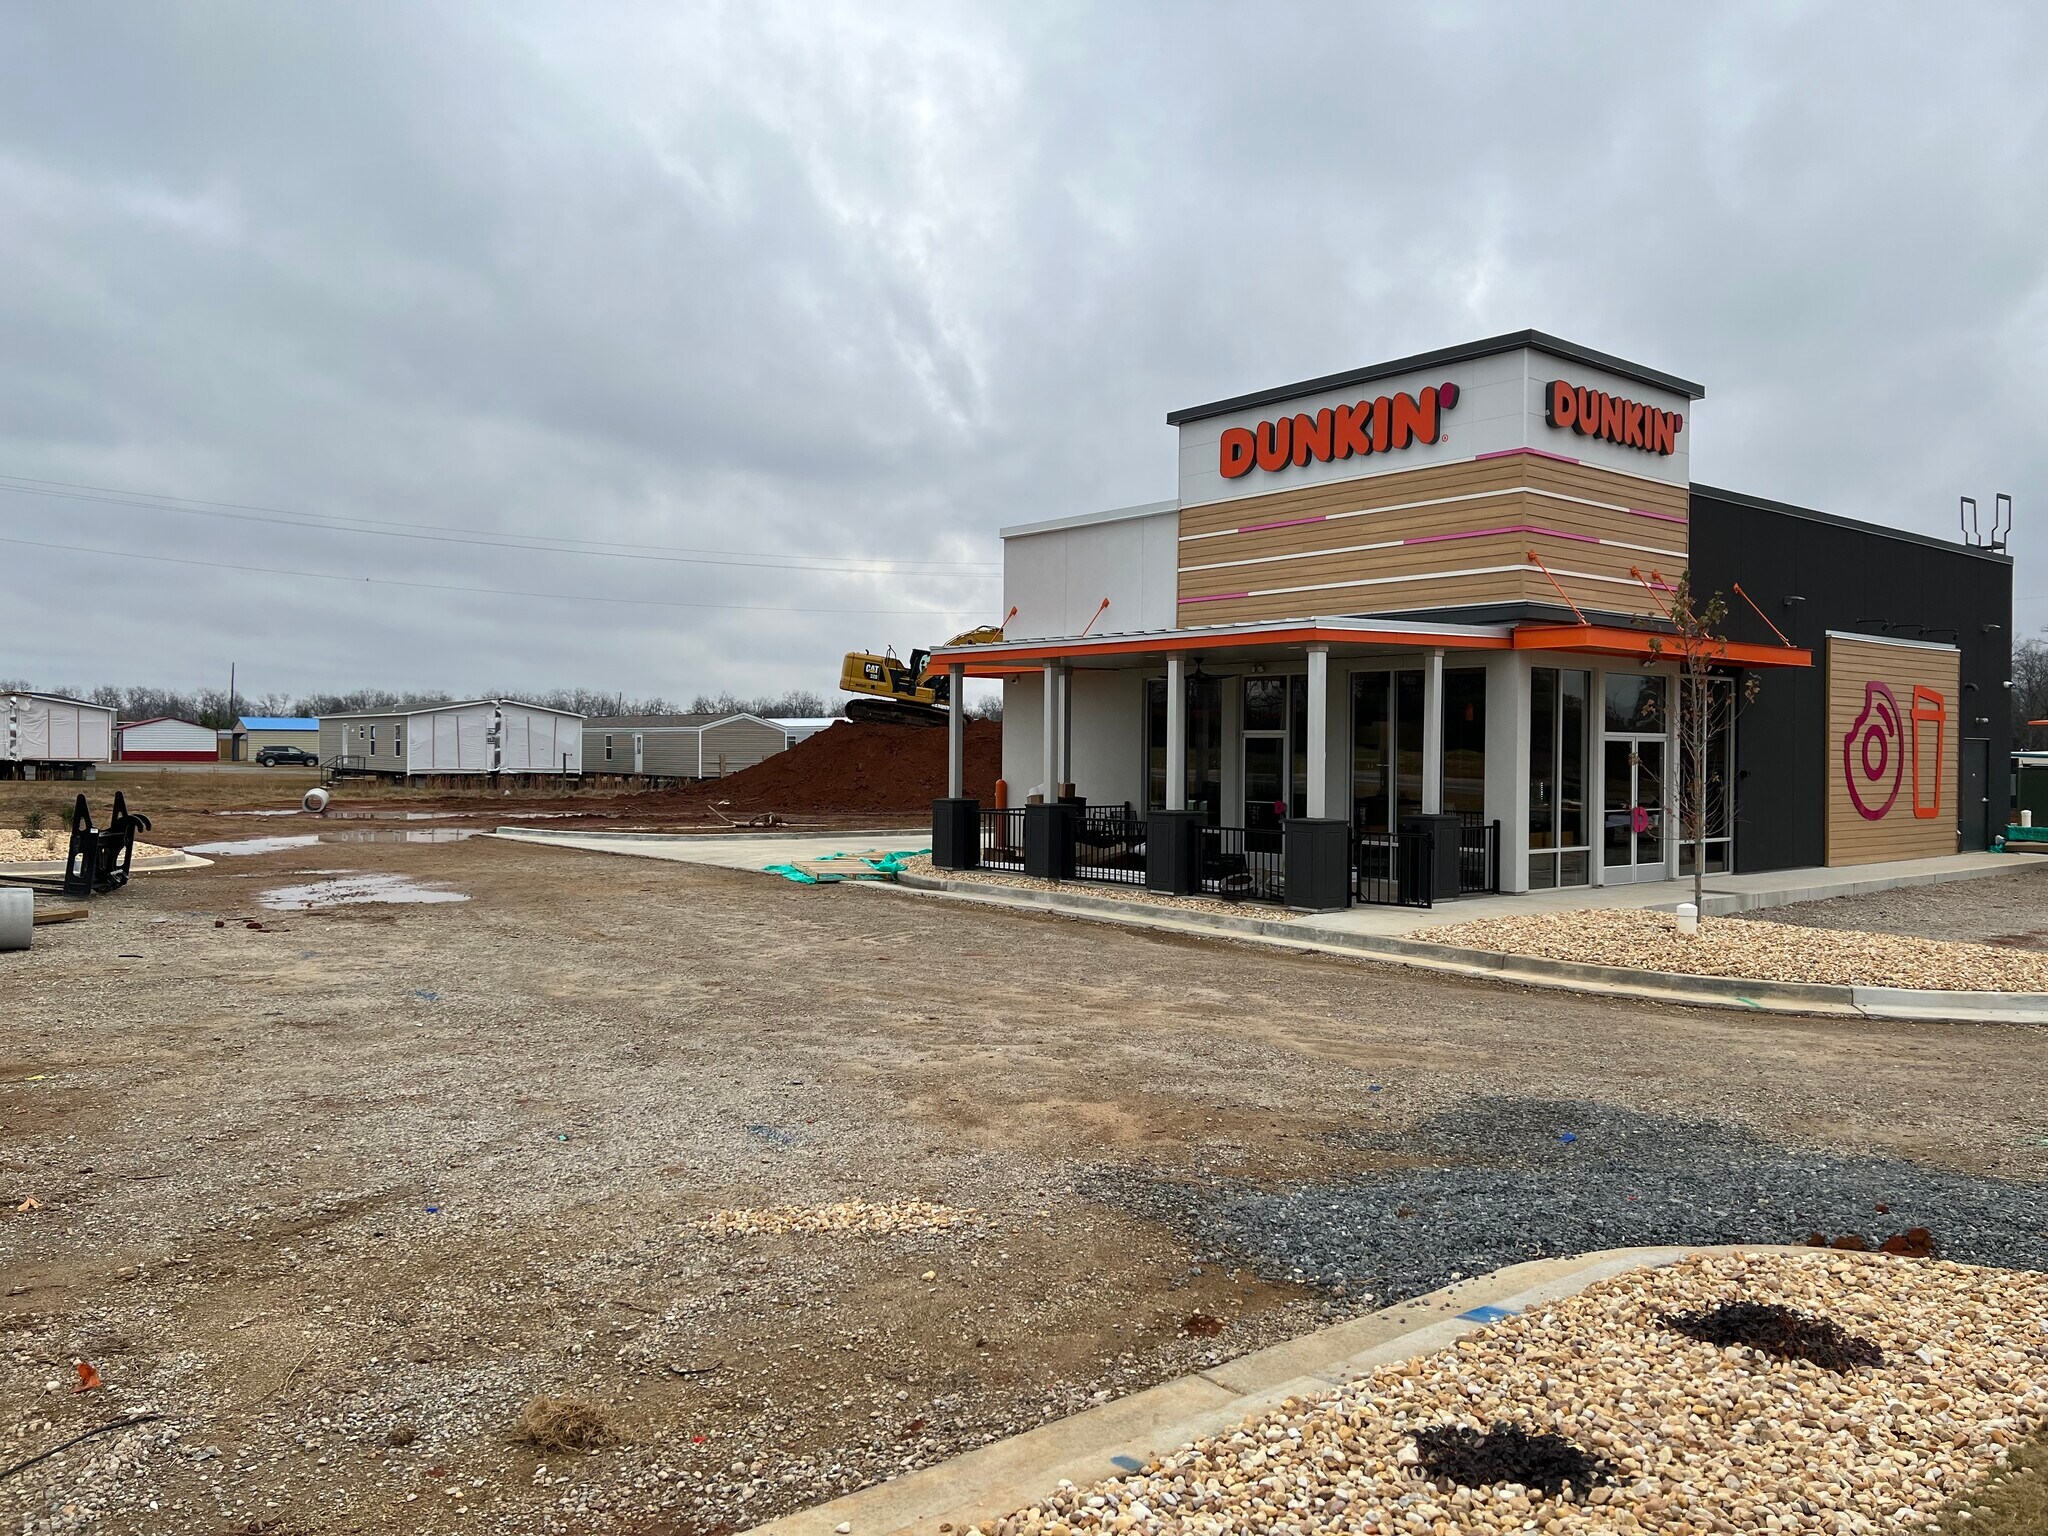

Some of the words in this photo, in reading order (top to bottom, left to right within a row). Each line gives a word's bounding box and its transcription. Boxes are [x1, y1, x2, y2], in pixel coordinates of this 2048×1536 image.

[1220, 382, 1460, 478] DUNKIN'
[1546, 379, 1683, 456] DUNKIN'
[865, 664, 880, 674] CAT
